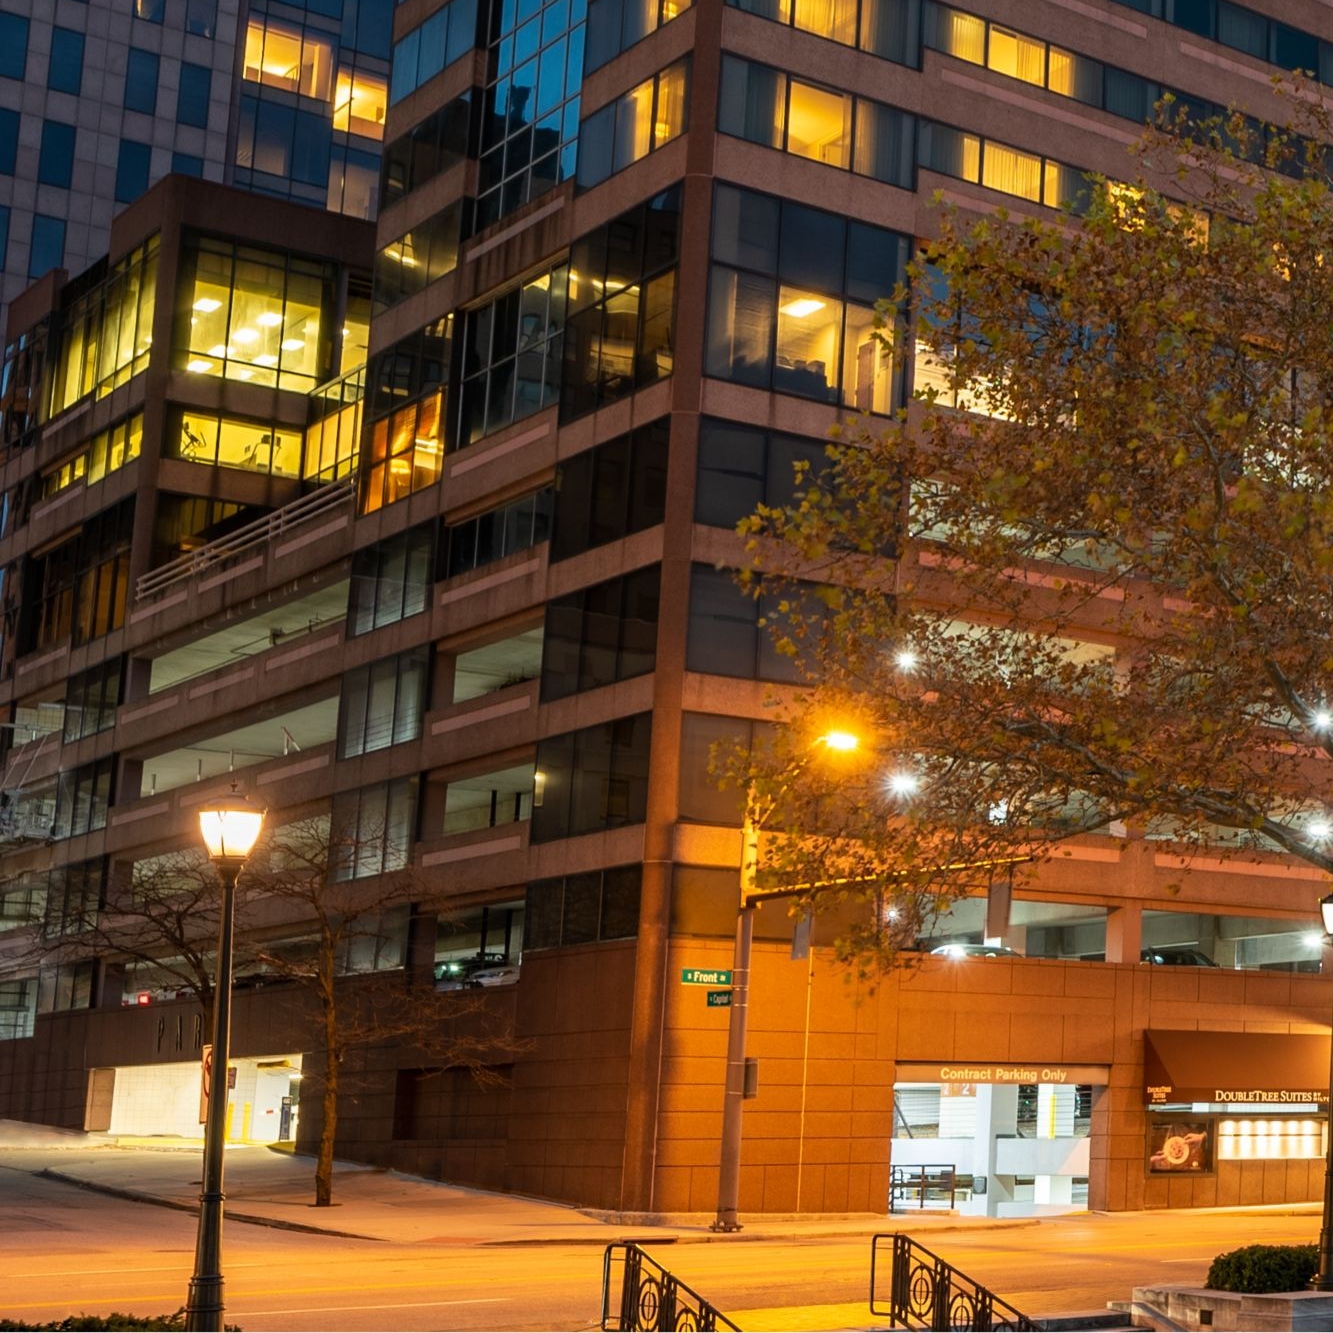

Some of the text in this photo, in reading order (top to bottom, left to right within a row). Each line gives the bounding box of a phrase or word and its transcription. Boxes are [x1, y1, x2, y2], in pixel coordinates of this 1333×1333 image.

[693, 971, 718, 983] Front
[157, 1013, 201, 1054] PAR
[940, 1067, 1067, 1082] Contract Parking Only
